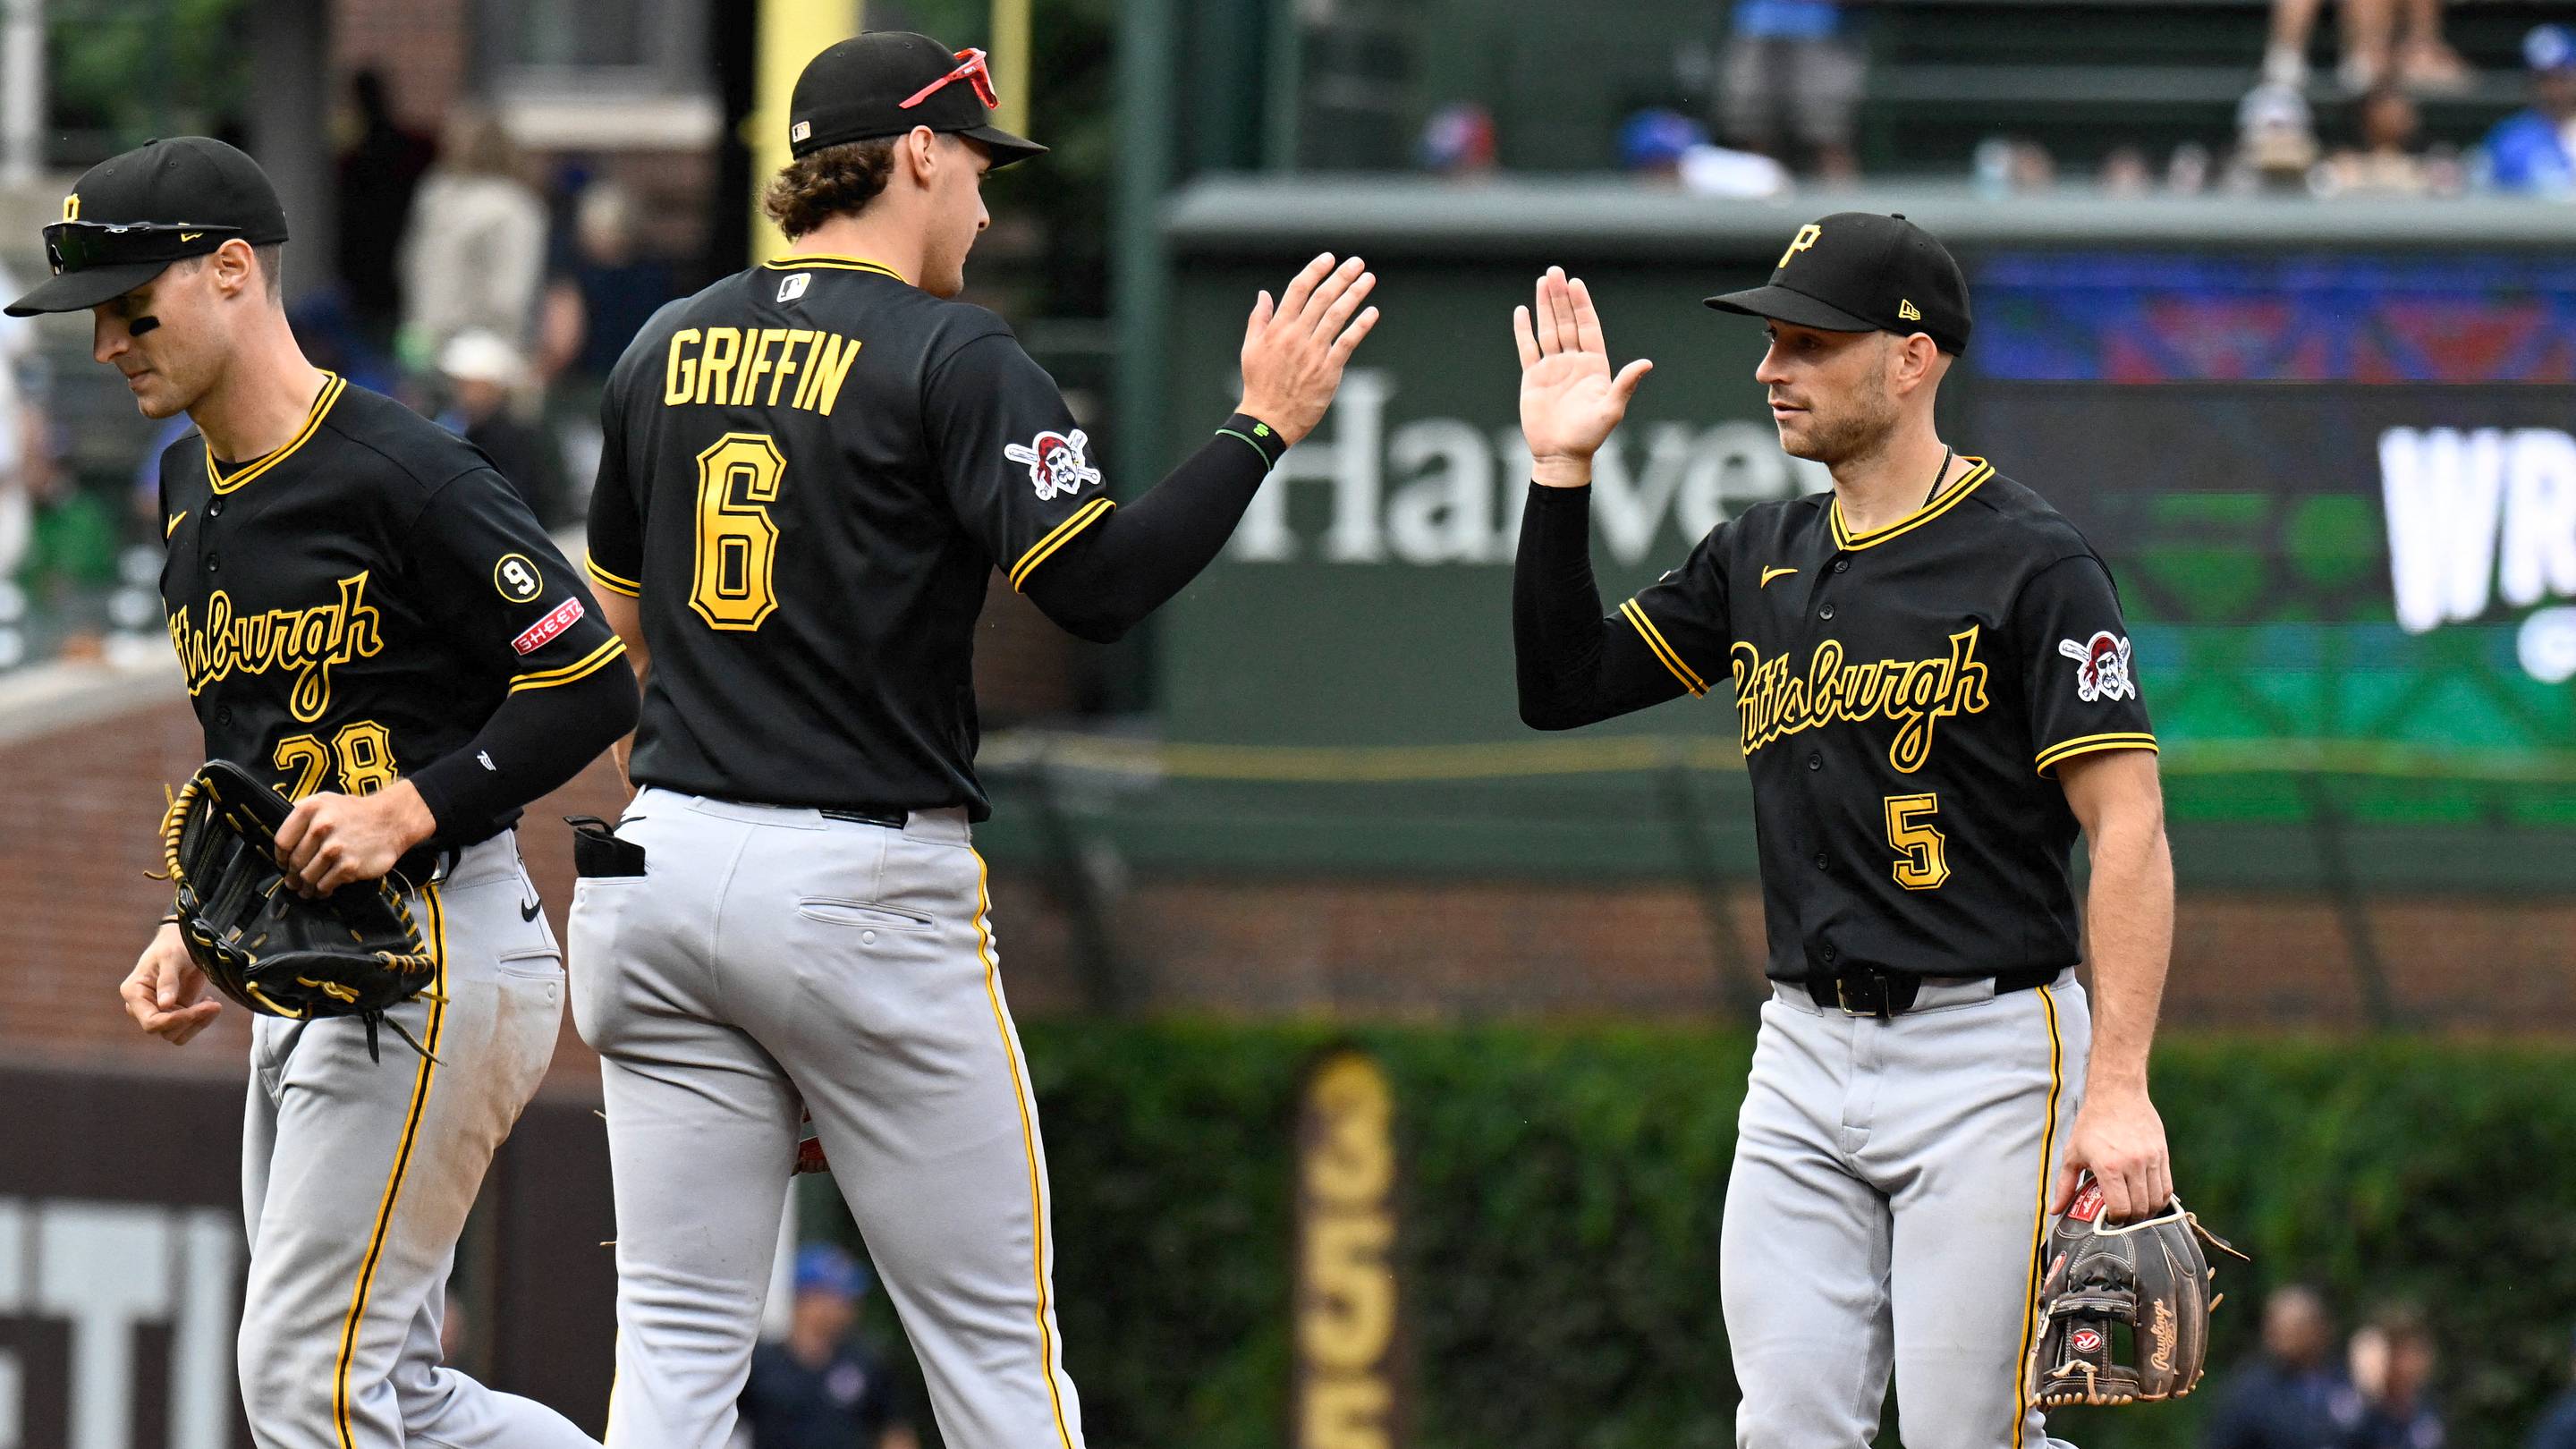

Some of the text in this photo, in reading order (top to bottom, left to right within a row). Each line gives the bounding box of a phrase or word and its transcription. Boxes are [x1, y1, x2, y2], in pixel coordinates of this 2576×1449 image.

[1778, 224, 1822, 268] P
[665, 327, 862, 416] GRIFFIN
[1233, 360, 1835, 569] Have
[688, 432, 788, 631] 6
[503, 560, 536, 595] 9
[165, 569, 384, 723] ttsburgh
[518, 601, 582, 651] SHEETZ
[1730, 623, 1989, 774] Pittsburgh
[272, 719, 400, 804] 28
[1884, 792, 1952, 890] 5
[2150, 1298, 2174, 1371] Rawlings
